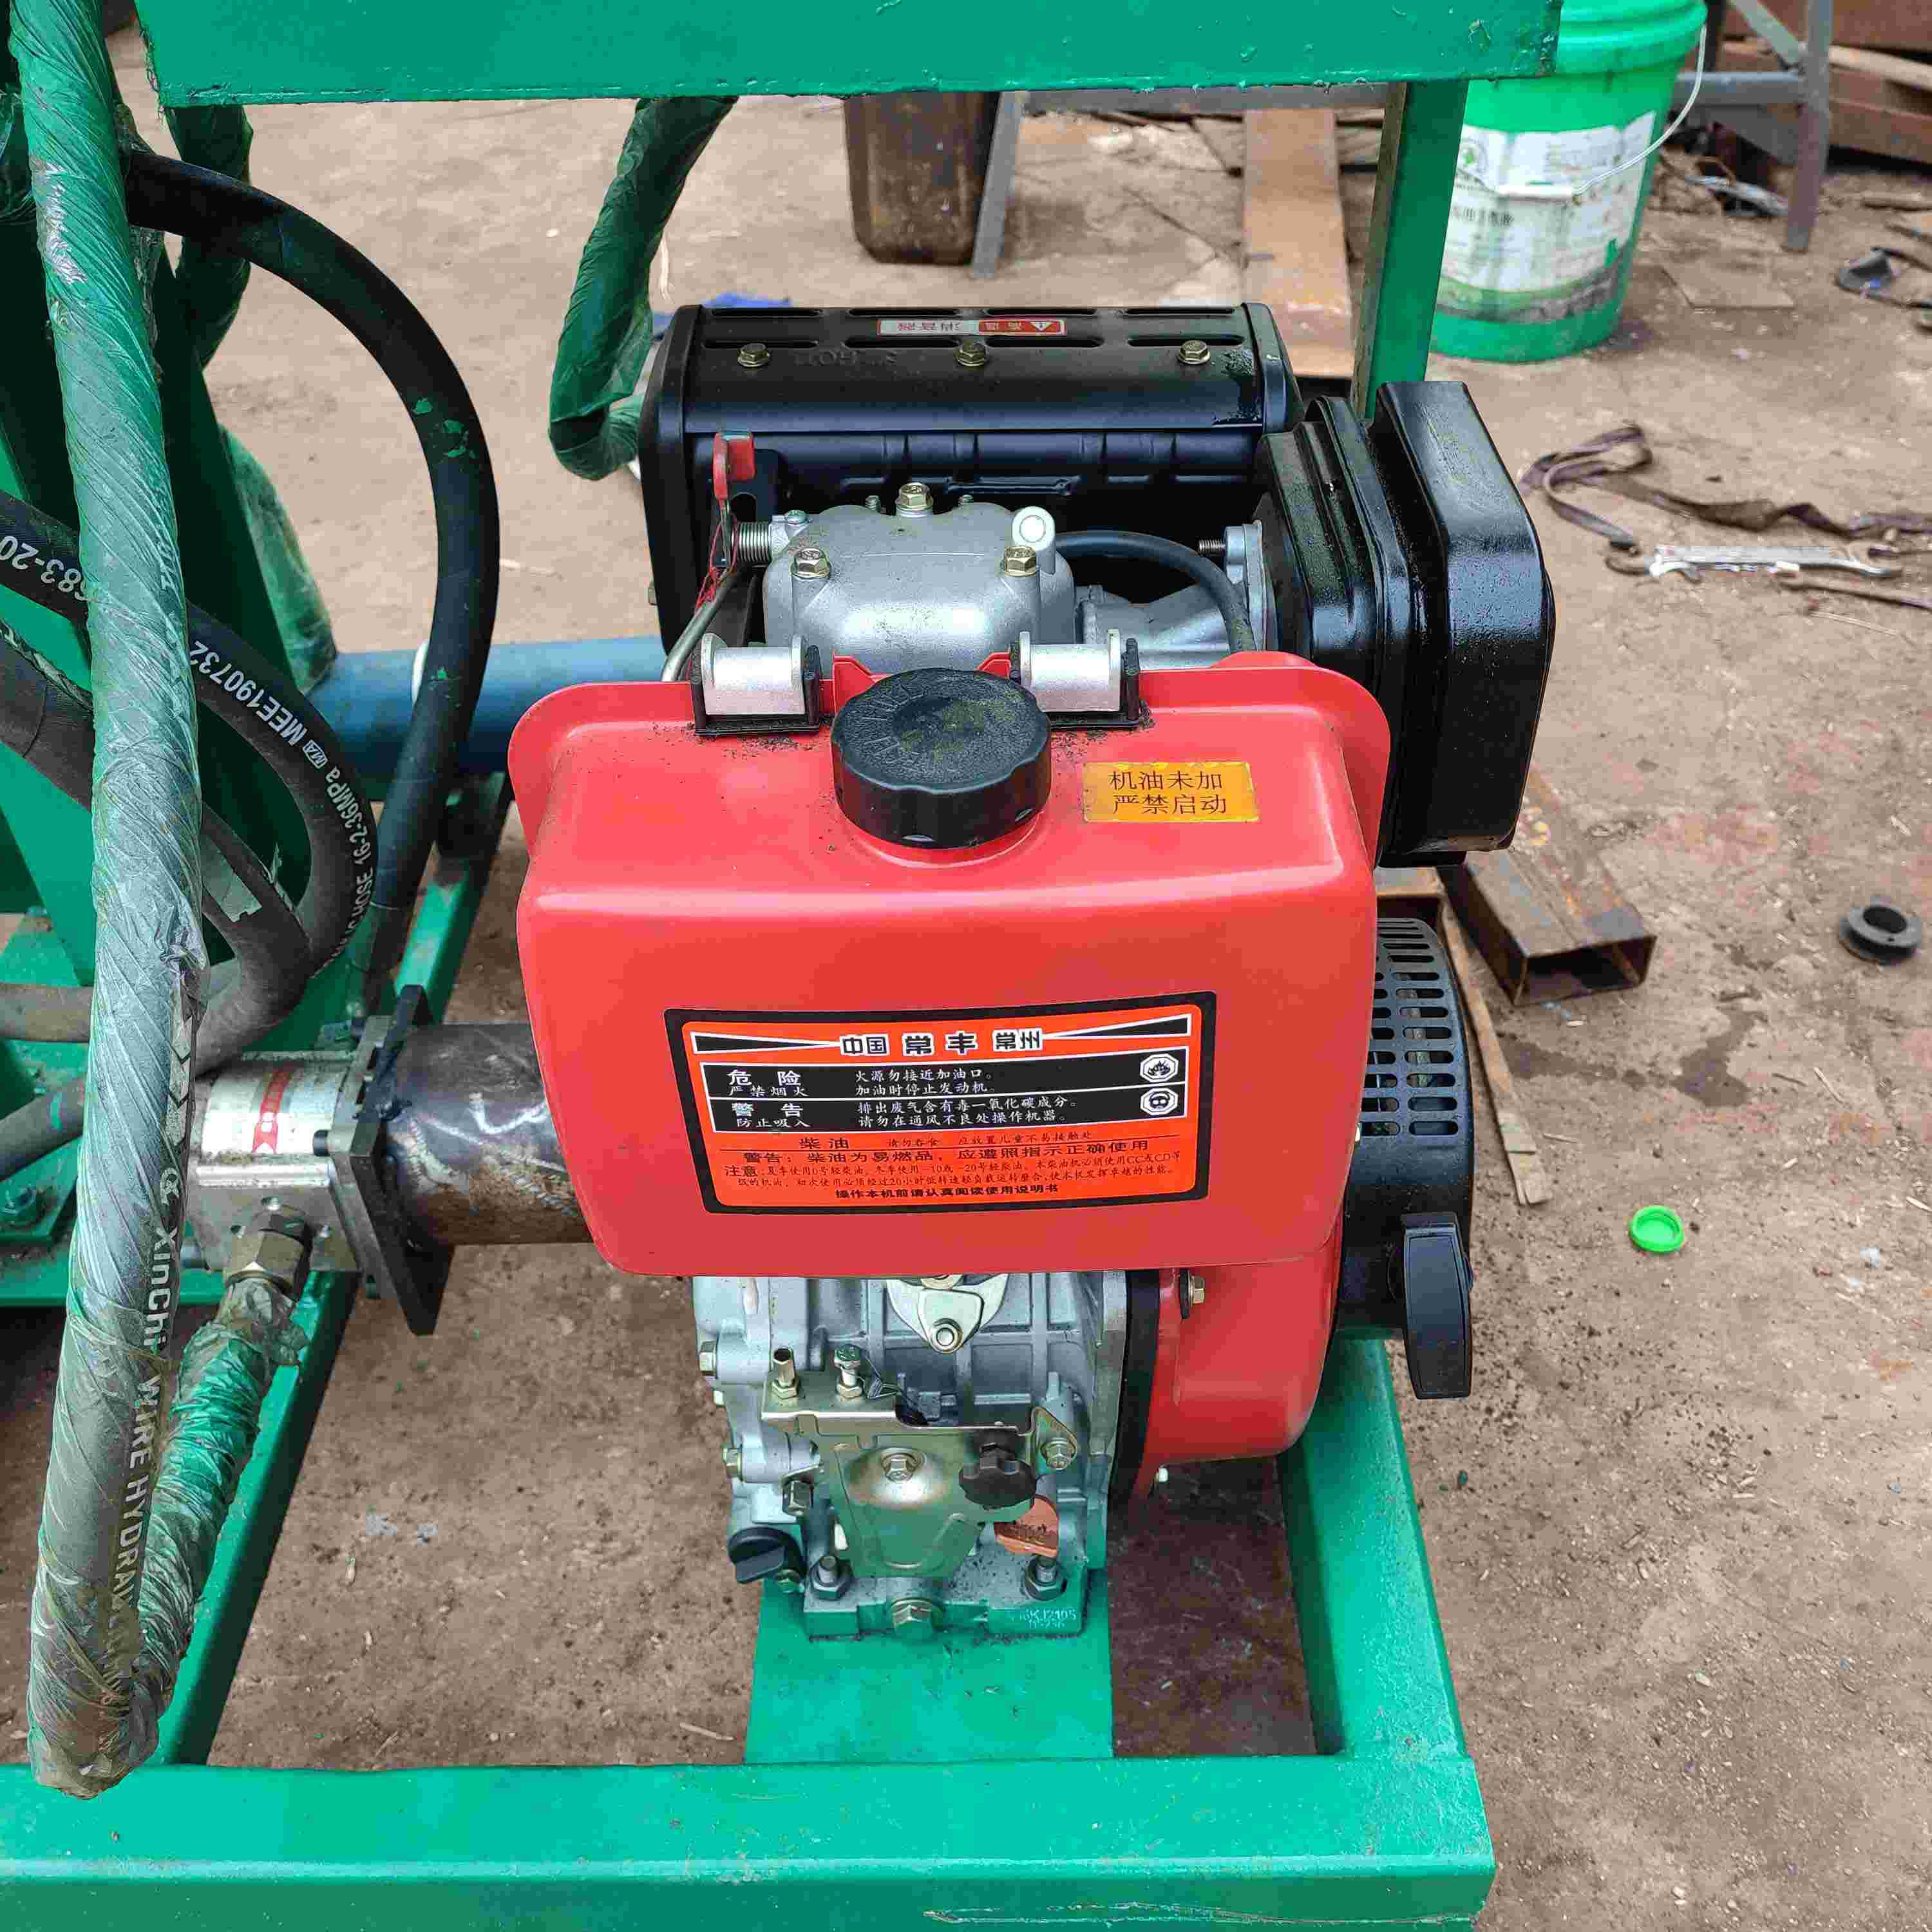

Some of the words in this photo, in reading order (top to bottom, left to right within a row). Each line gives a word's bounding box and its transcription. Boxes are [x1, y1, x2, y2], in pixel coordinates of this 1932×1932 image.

[189, 641, 308, 746] MEE190732
[1108, 770, 1223, 791] 机油未加
[1112, 794, 1227, 815] 严禁启动
[325, 766, 372, 864] 16-2-36MPa
[840, 1035, 888, 1055] 中国
[994, 1031, 1041, 1050] 常州
[728, 1069, 801, 1086] 危险
[855, 1068, 992, 1083] 火源勿接近加油口。
[728, 1086, 809, 1097] 严禁烟火
[855, 1081, 995, 1096] 加油时停止发动机。
[732, 1102, 804, 1117] 警告
[737, 1117, 810, 1128] 防止吸入
[799, 1137, 849, 1149] 柴油
[129, 1374, 160, 1470] WIRE
